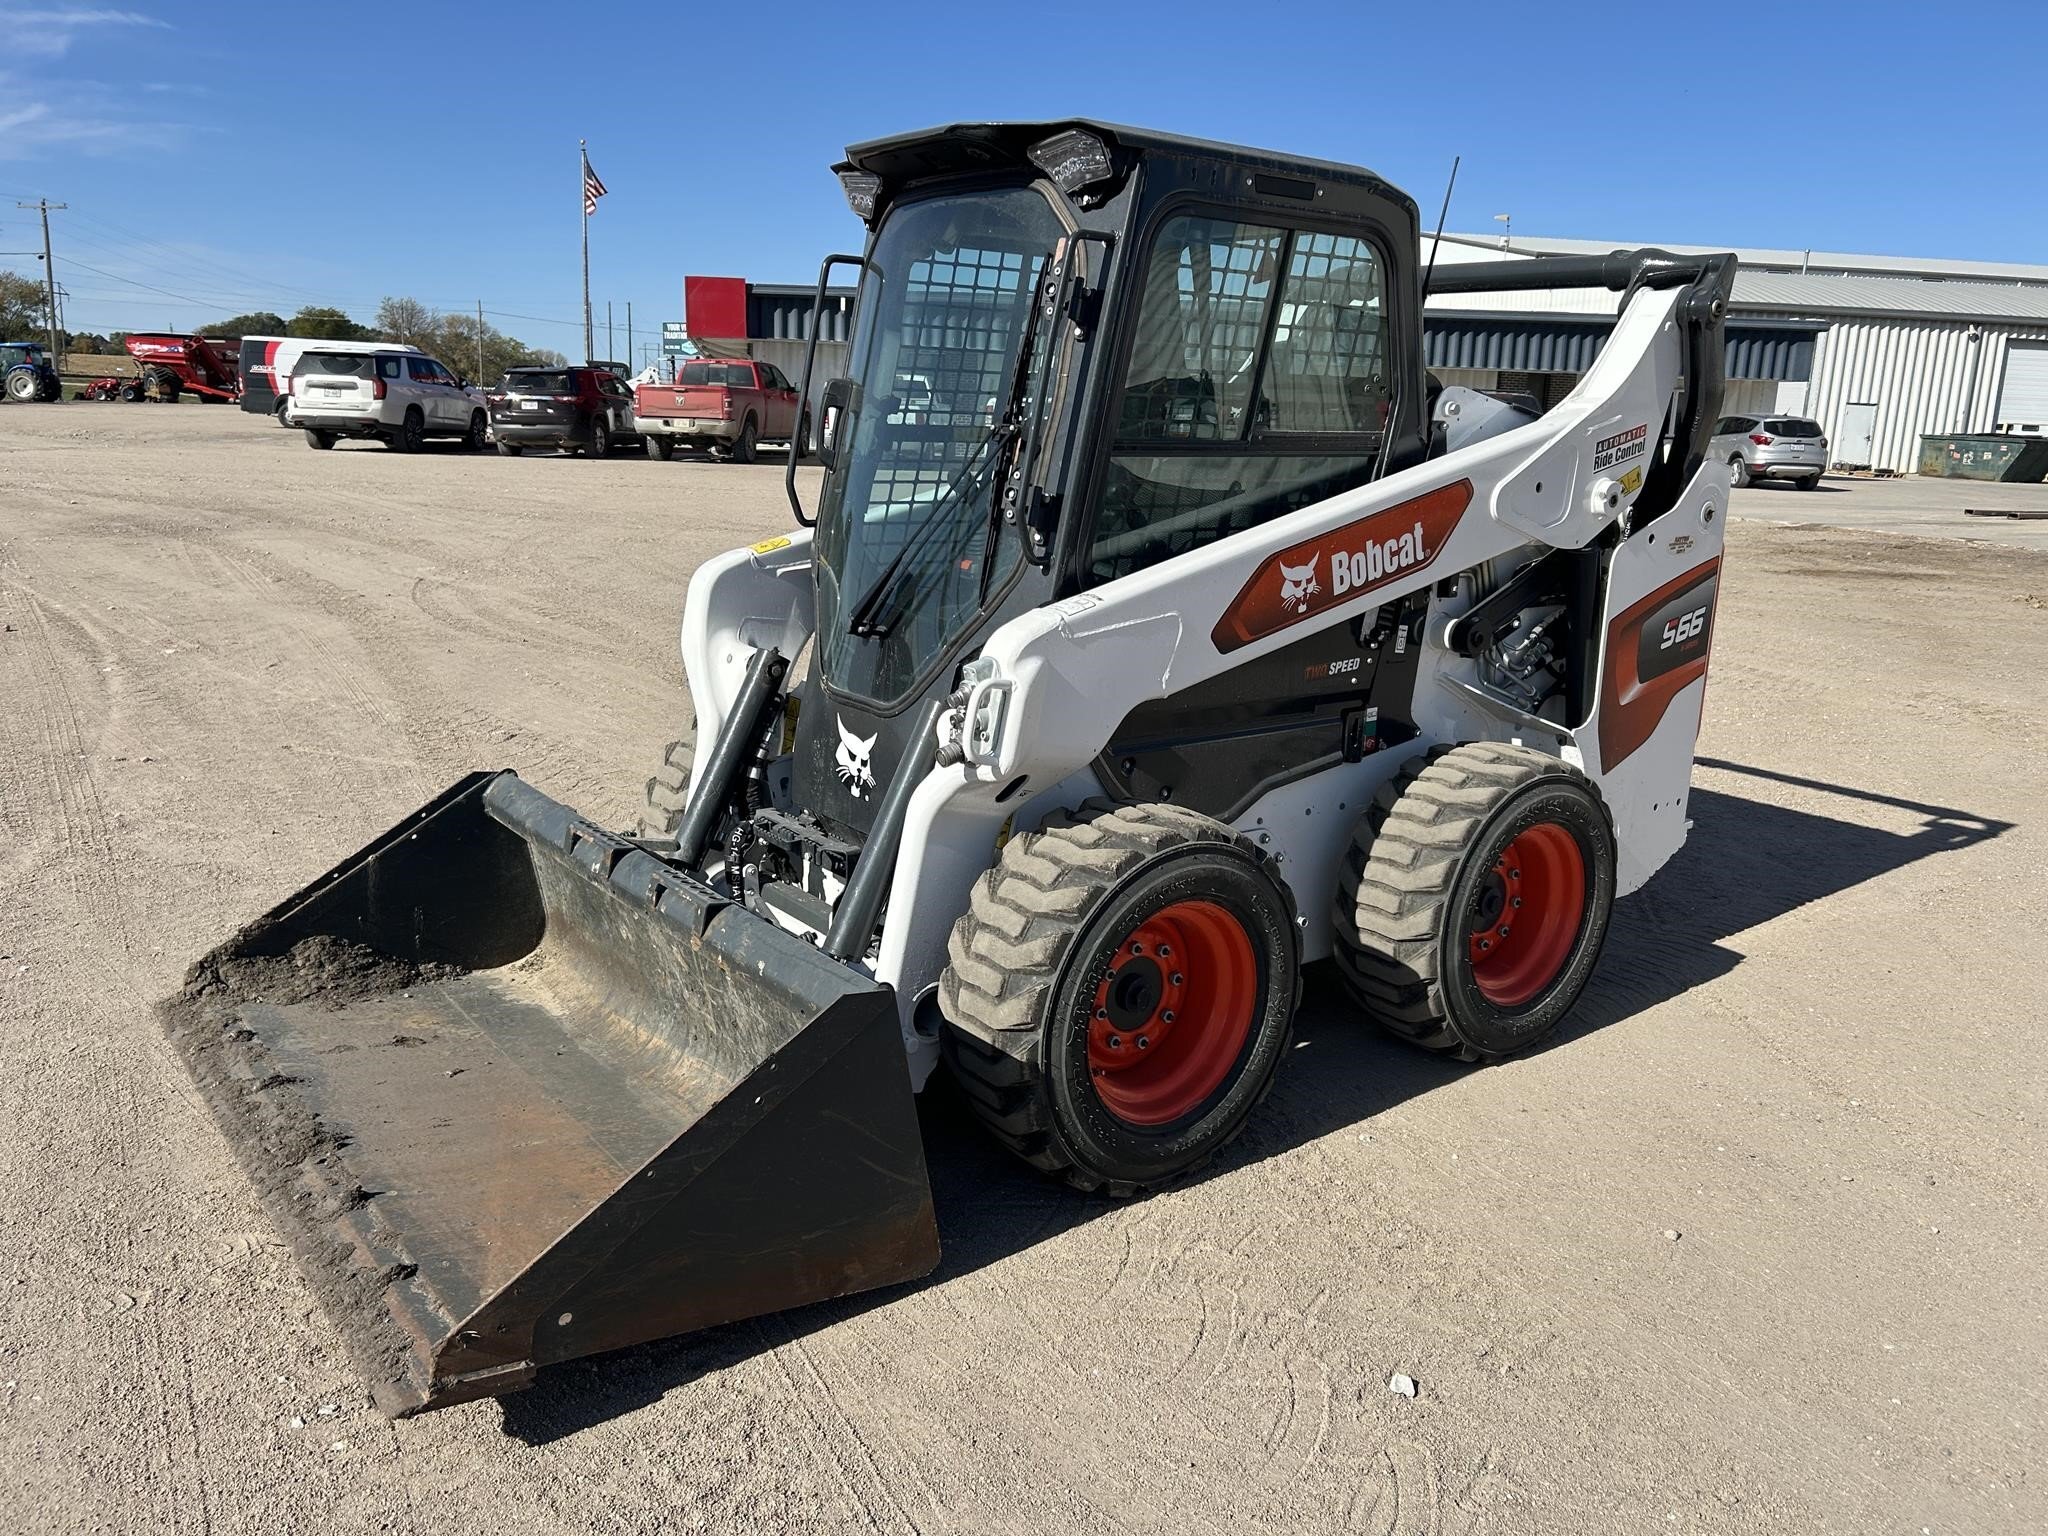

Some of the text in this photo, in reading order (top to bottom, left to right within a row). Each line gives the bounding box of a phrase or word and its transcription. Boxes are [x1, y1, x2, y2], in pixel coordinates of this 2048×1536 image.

[1593, 437, 1646, 471] Ride Control
[1596, 426, 1647, 454] AUTOMATIC
[1331, 521, 1425, 596] Bobcat
[1660, 606, 1707, 650] S66
[1329, 658, 1360, 675] SPEED
